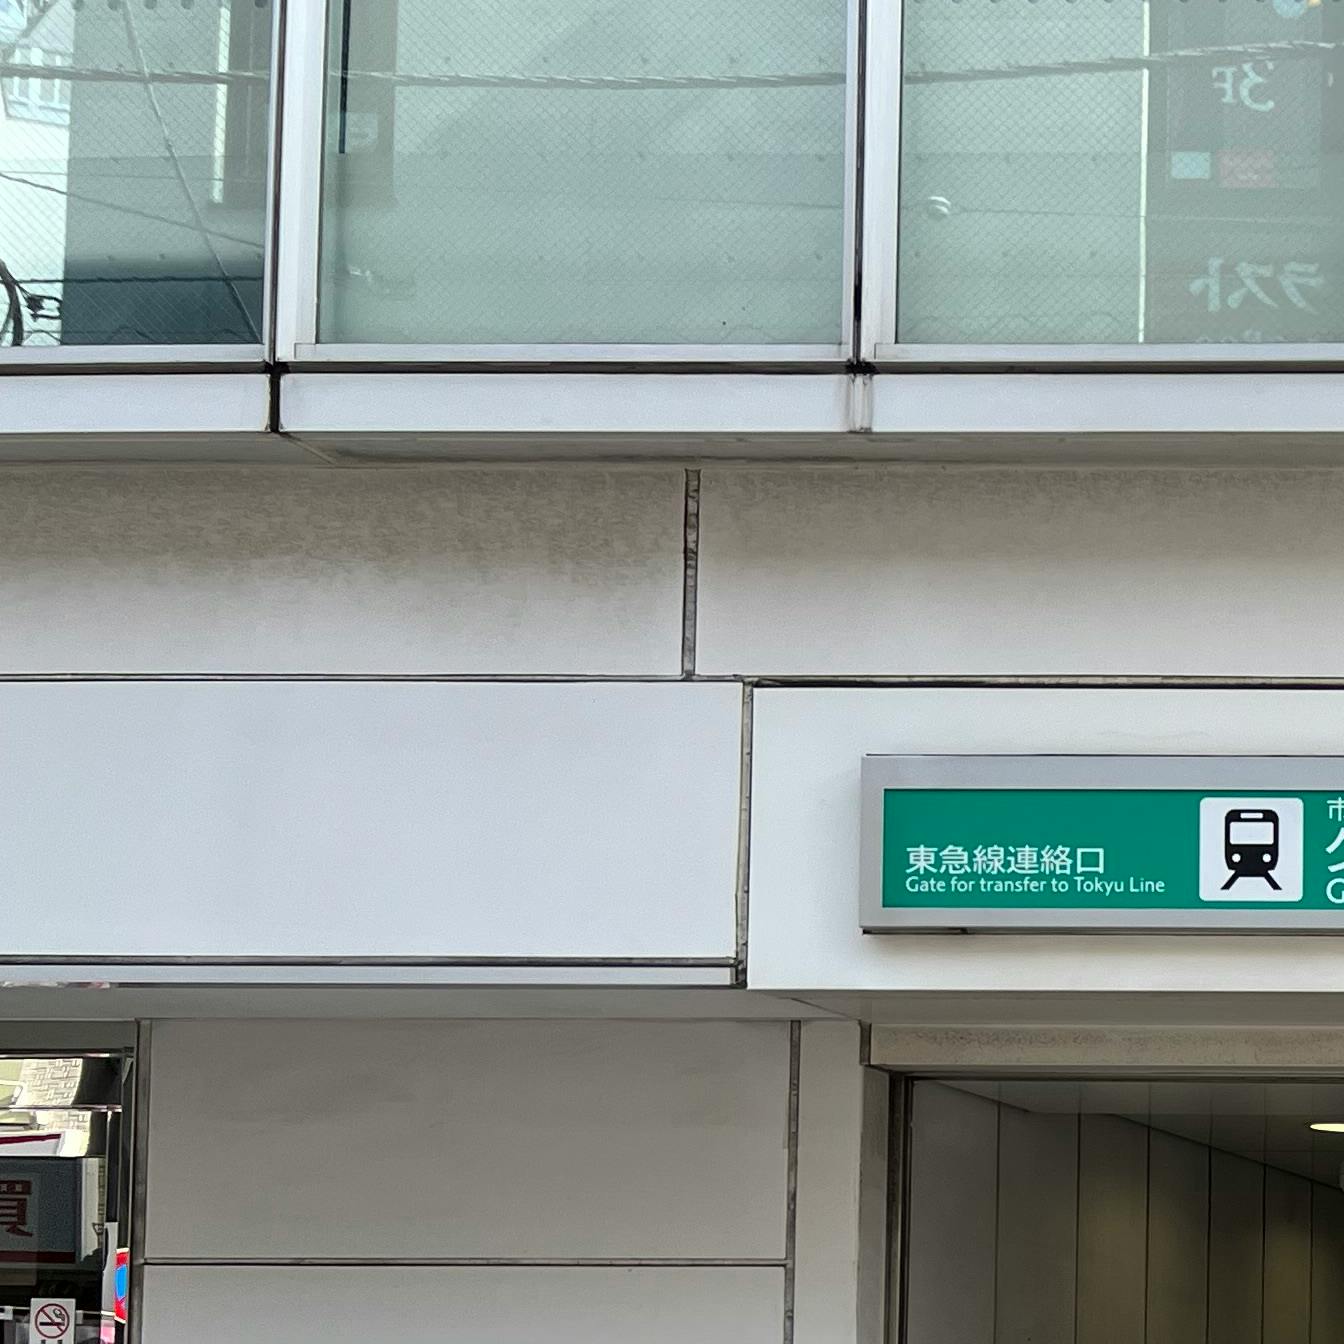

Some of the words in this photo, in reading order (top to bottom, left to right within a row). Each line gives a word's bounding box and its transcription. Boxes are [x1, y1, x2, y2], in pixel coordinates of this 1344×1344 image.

[905, 844, 1105, 875] 東急線連絡口
[905, 876, 947, 893] Gate
[950, 876, 975, 893] for
[979, 876, 1047, 893] transfer
[1050, 878, 1069, 893] to
[1073, 876, 1125, 896] Tokyu
[1129, 877, 1166, 893] Line
